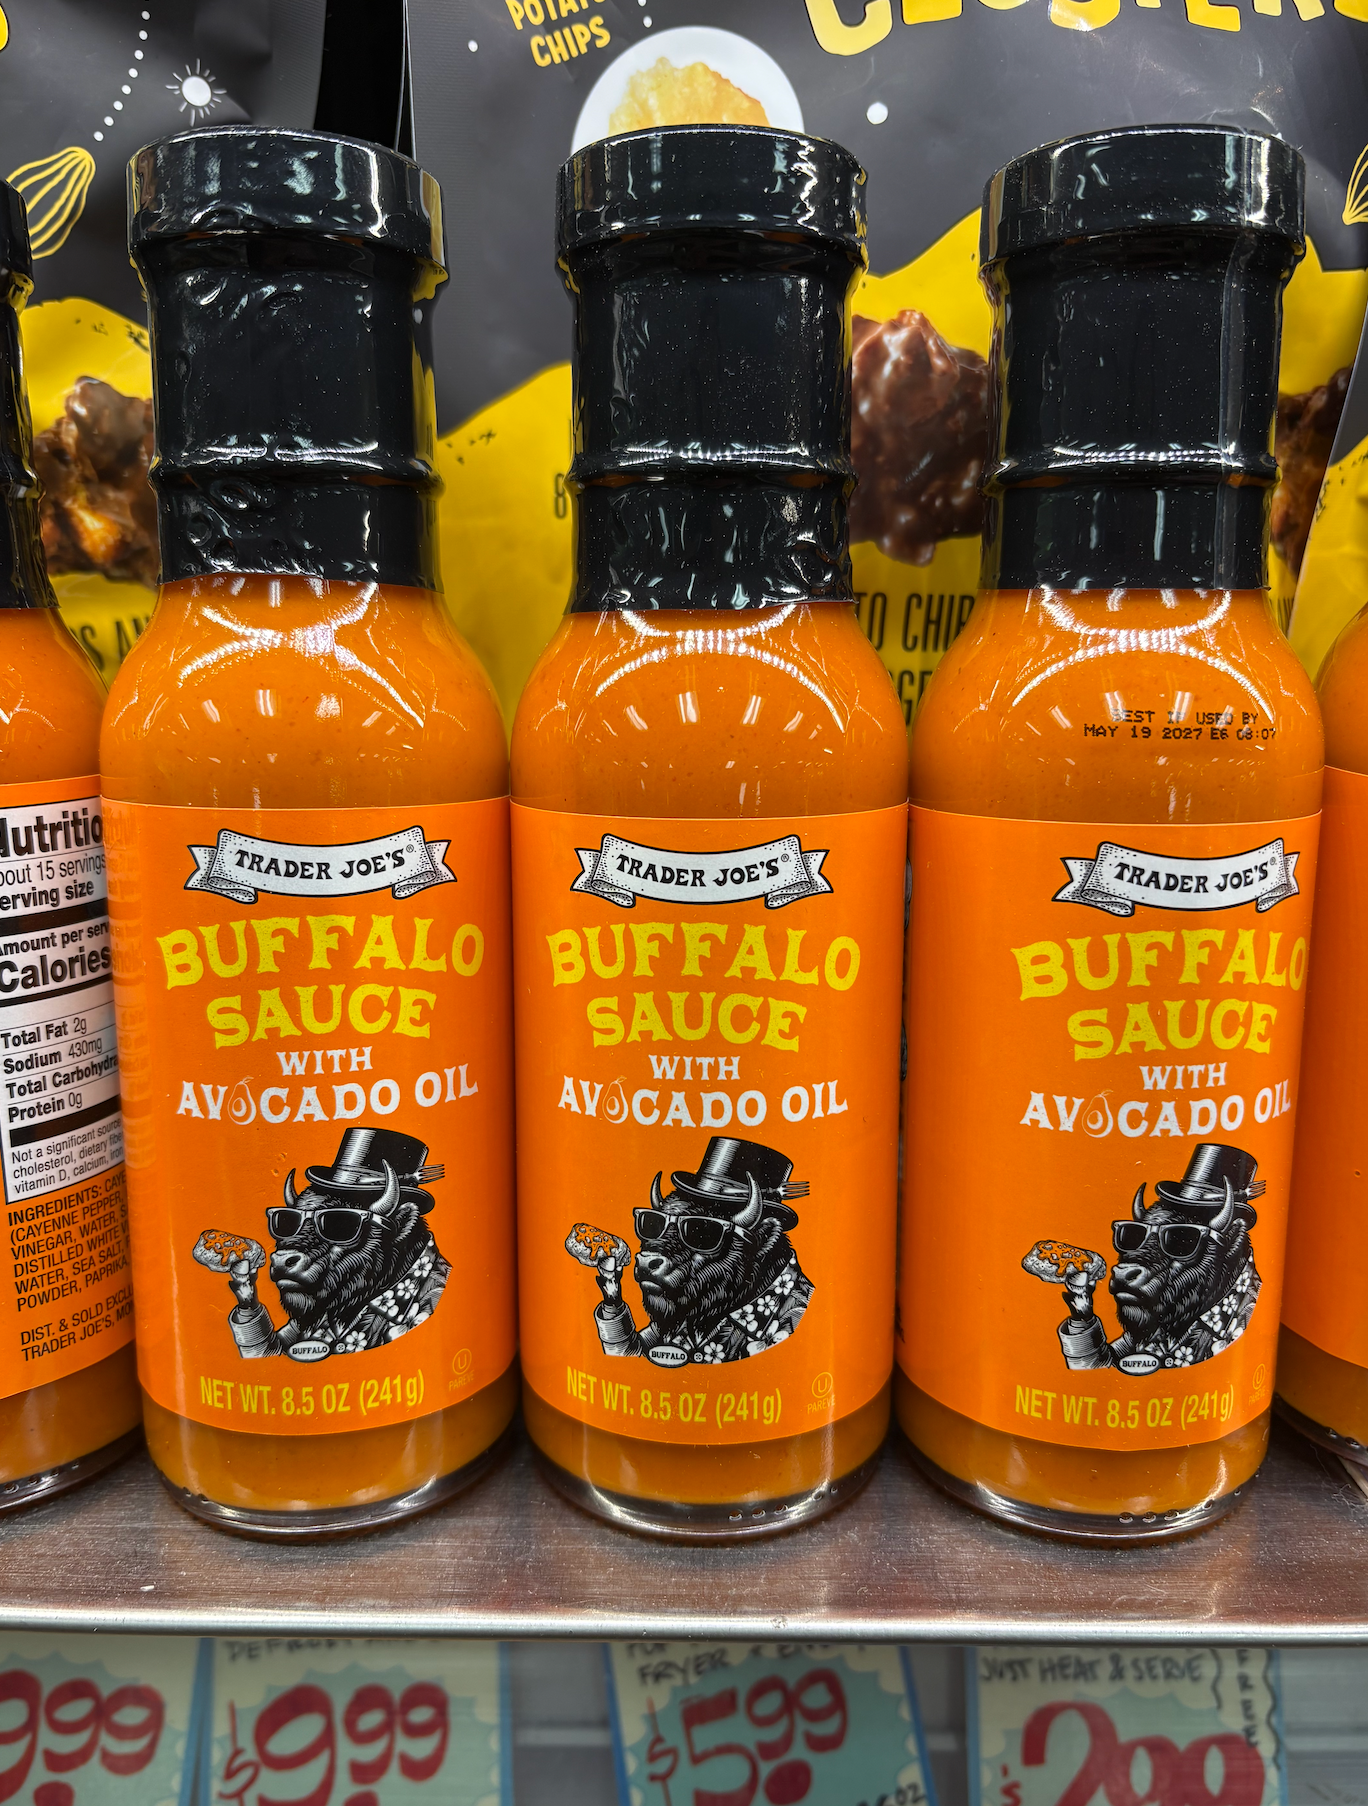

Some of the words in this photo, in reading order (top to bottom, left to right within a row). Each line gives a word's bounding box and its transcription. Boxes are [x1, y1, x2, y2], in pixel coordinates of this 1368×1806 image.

[530, 15, 611, 68] CHIPS
[1084, 723, 1118, 737] MAY
[1131, 726, 1151, 738] 19
[1162, 727, 1202, 740] 2027
[1196, 711, 1234, 726] USED
[1242, 712, 1258, 725] BY
[37, 860, 55, 881] 15
[234, 849, 332, 880] TRADER
[616, 853, 706, 887] TRADER
[1114, 861, 1209, 893] TRADER
[65, 879, 94, 901] size
[61, 928, 84, 949] per
[156, 914, 484, 990] BUFFALO
[546, 922, 861, 991] BUFFALO
[0, 945, 111, 994] Calories
[1010, 928, 1307, 1002] BUFFALO
[1, 1026, 41, 1050] Total
[46, 1021, 69, 1040] Fat
[73, 1017, 87, 1034] 2g
[206, 983, 437, 1050] SAUCE
[586, 991, 807, 1053] SAUCE
[1067, 998, 1278, 1062] SAUCE
[3, 1050, 62, 1075] Sodium
[68, 1037, 103, 1059] 430mg
[276, 1046, 373, 1076] WITH
[648, 1054, 740, 1081] WITH
[1139, 1061, 1227, 1091] WITH
[6, 1075, 48, 1099] Total
[415, 1063, 479, 1107] OIL
[781, 1079, 848, 1122] OIL
[1253, 1079, 1291, 1124] OIL
[8, 1097, 65, 1123] Protein
[68, 1091, 83, 1109] 0g
[12, 1149, 33, 1164] Not
[36, 1148, 43, 1158] a
[46, 1127, 96, 1156] significant
[13, 1152, 77, 1179] cholesterol,
[79, 1137, 108, 1159] dietary
[14, 1171, 56, 1194] vitamin
[59, 1168, 71, 1182] D,
[74, 1156, 109, 1178] calcium,
[8, 1185, 103, 1227] INGREDIENTS:
[10, 1213, 79, 1246] (CAYENNE
[83, 1190, 123, 1221] PEPPER,
[11, 1231, 77, 1261] VINEGAR,
[79, 1211, 119, 1238] WATER,
[14, 1243, 83, 1278] DISTILLED
[87, 1224, 120, 1252] WHITE
[15, 1269, 69, 1295] WATER,
[73, 1256, 96, 1276] SEA
[99, 1239, 124, 1264] SALT,
[17, 1281, 82, 1312] POWDER,
[20, 1325, 56, 1345] DIST.
[59, 1319, 69, 1332] &
[72, 1303, 103, 1327] SOLD
[22, 1332, 76, 1362] TRADER
[80, 1315, 115, 1340] JOE'S,
[291, 1345, 328, 1355] BUFFALO
[651, 1351, 686, 1361] BUFFALO
[1122, 1359, 1157, 1368] BUFFALO
[200, 1375, 235, 1410] NET
[239, 1384, 276, 1414] WT.
[282, 1386, 314, 1416] 8.5
[322, 1382, 351, 1412] OZ
[359, 1369, 424, 1415] (241g)
[567, 1366, 597, 1404] NET
[602, 1379, 634, 1415] WT.
[640, 1389, 671, 1422] 8.5
[679, 1393, 705, 1423] OZ
[716, 1388, 782, 1429] (241g)
[1015, 1385, 1056, 1420] NET
[1062, 1394, 1098, 1426] WT.
[1106, 1399, 1139, 1429] 8.5
[1146, 1398, 1173, 1427] OZ
[1180, 1384, 1234, 1430] (241g)
[637, 1647, 729, 1687] FRYER
[981, 1656, 1032, 1682] JUST
[1038, 1654, 1100, 1682] HEAT
[1109, 1652, 1124, 1681] &
[1130, 1652, 1205, 1682] SERVE
